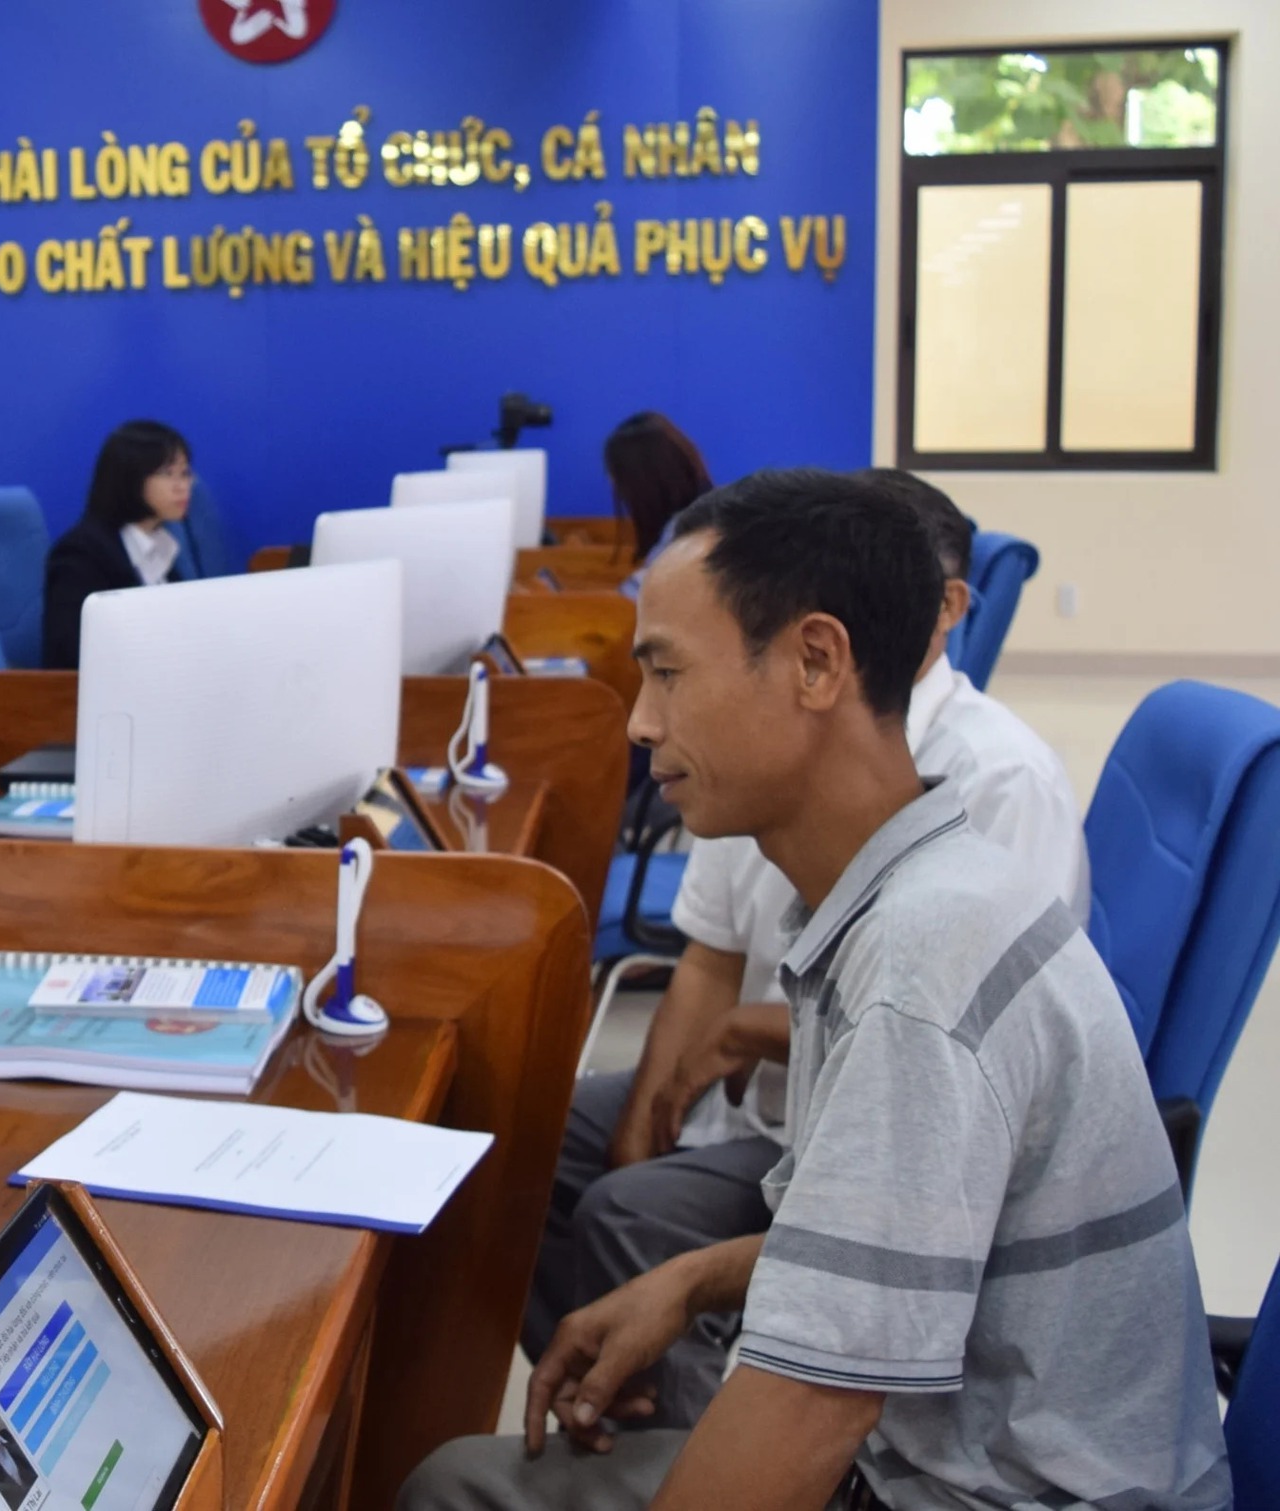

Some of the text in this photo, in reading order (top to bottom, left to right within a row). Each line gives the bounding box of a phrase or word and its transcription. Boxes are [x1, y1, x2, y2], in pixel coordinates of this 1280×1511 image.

[70, 130, 190, 199] LÒNG
[200, 118, 294, 193] CỦA
[304, 104, 372, 191] TỔ
[541, 110, 607, 180] CÁ
[623, 106, 760, 178] NHÂN
[35, 216, 153, 292] CHẤT
[162, 224, 314, 298] LƯỢNG
[323, 213, 387, 282] VÀ
[398, 211, 512, 291] HIỆU
[523, 199, 621, 288] QUẢ
[634, 215, 768, 285] PHỤC
[780, 214, 846, 283] VỤ
